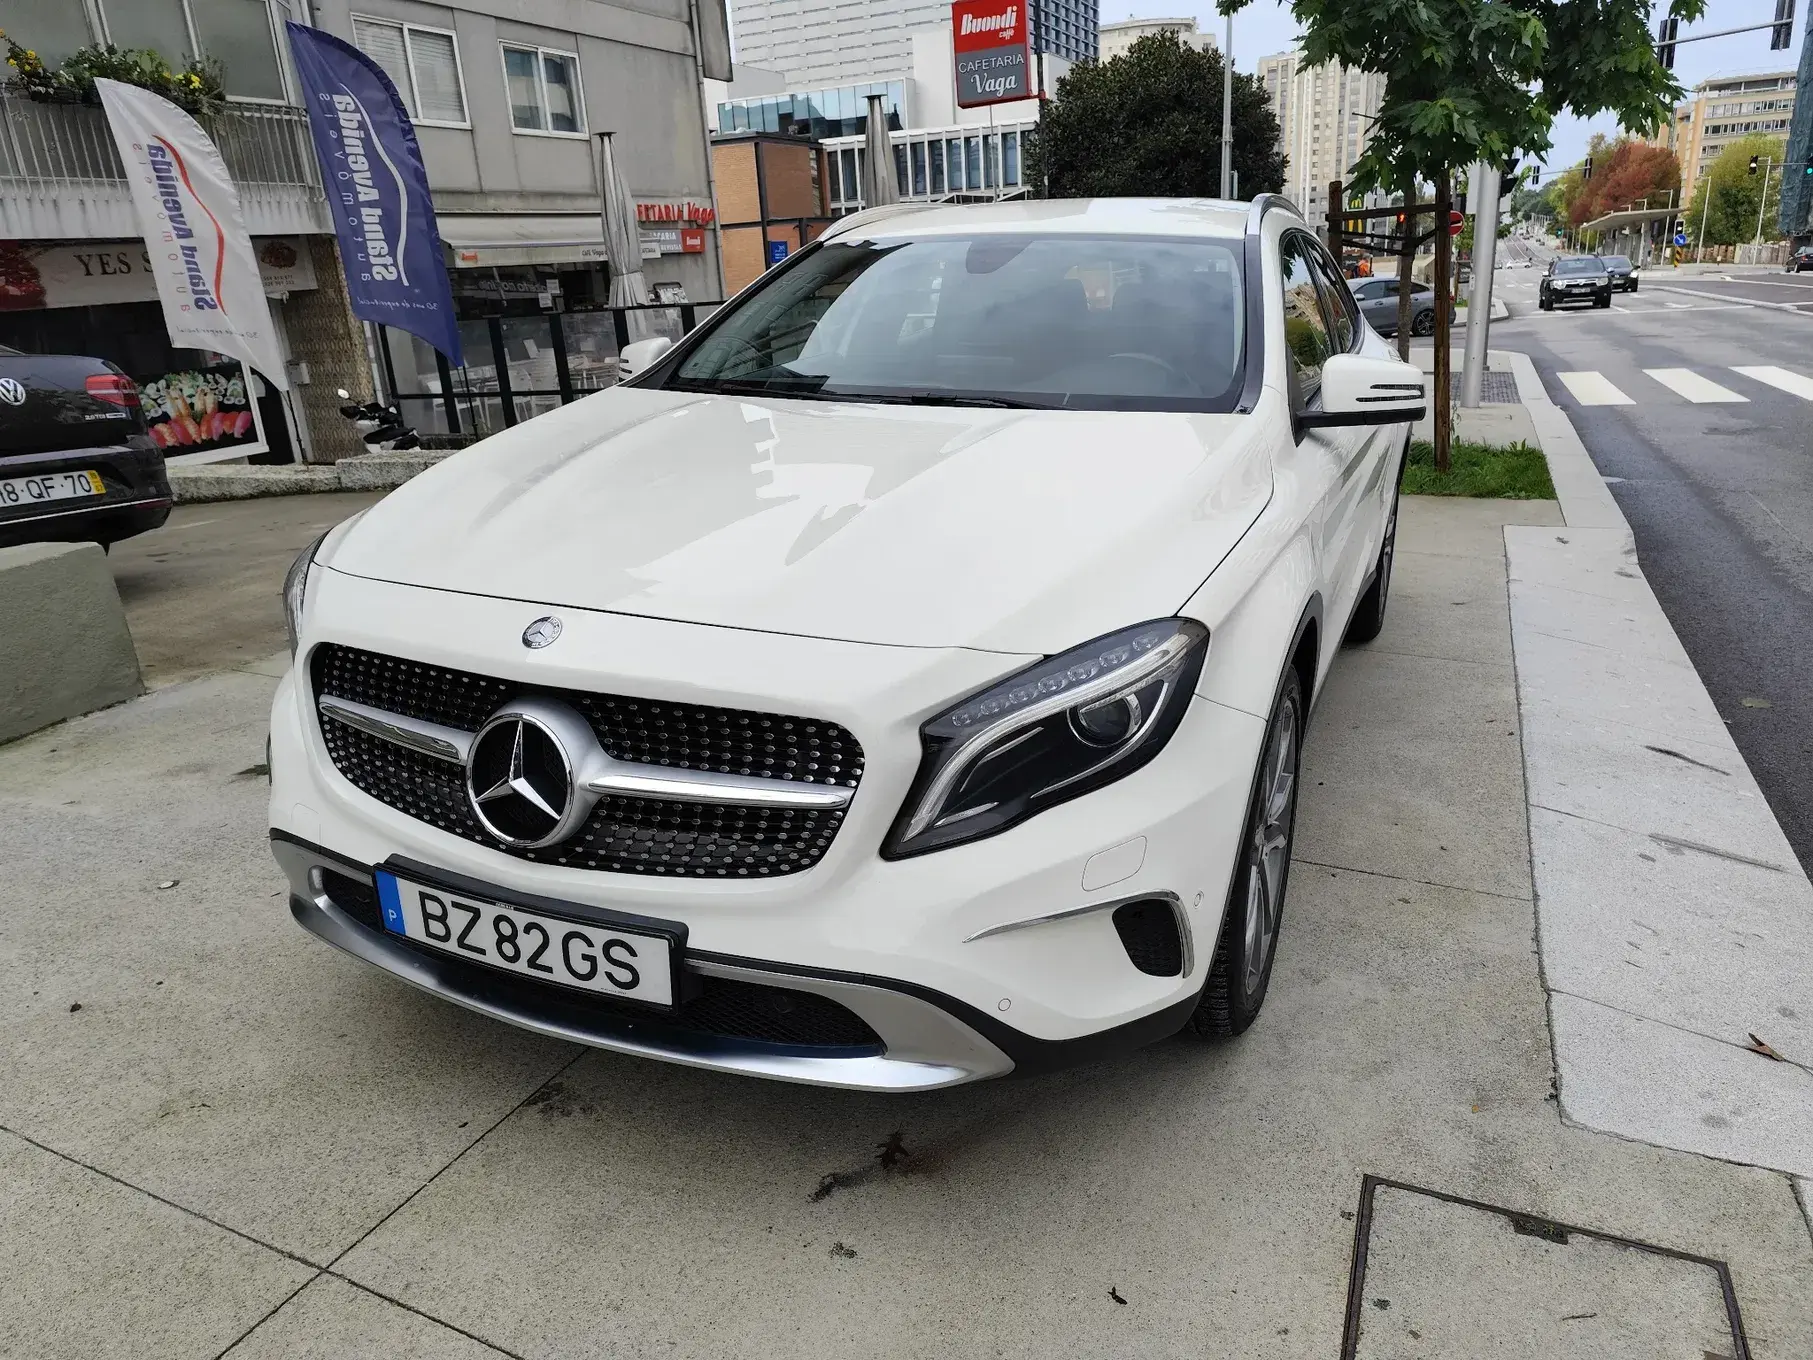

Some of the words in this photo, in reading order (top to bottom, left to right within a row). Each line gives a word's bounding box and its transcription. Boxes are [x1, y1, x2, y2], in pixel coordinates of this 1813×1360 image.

[960, 6, 1018, 36] Buondi
[958, 53, 1025, 73] CAFETARIA
[970, 72, 1018, 97] Vaga
[636, 203, 683, 223] FETARIA
[73, 251, 132, 277] YES
[388, 908, 397, 922] P
